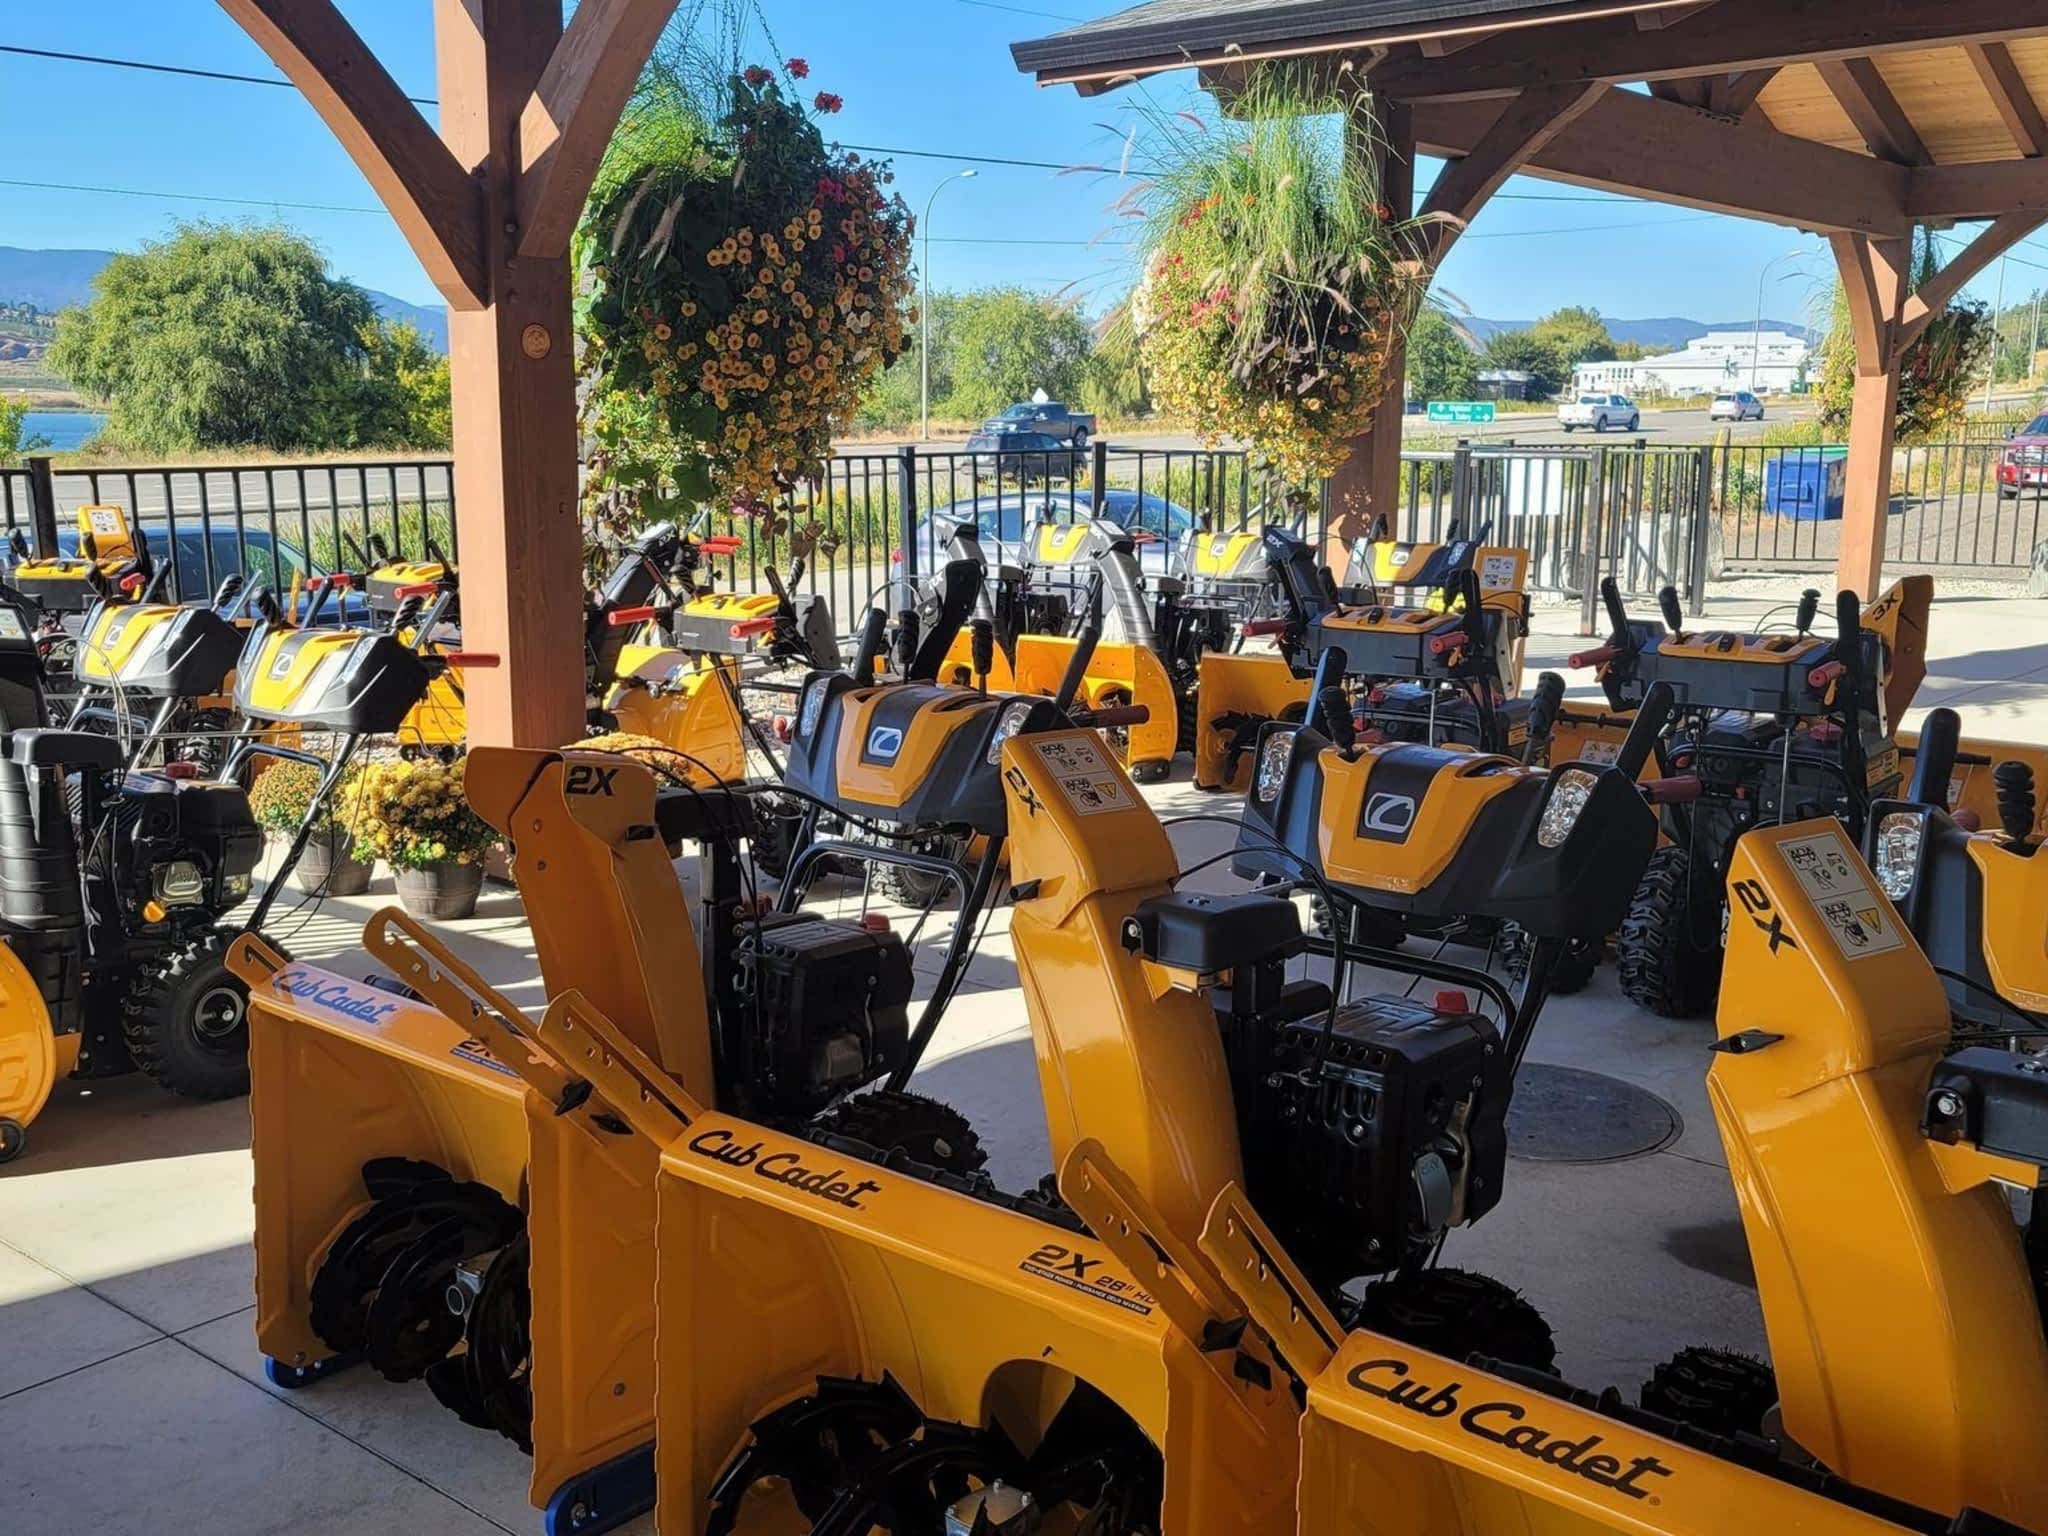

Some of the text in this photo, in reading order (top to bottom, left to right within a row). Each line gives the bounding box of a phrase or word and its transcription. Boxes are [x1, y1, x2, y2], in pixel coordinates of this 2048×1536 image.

[1872, 591, 1898, 621] 3X
[566, 766, 620, 796] 2X
[1004, 766, 1045, 817] 2X
[1731, 879, 1800, 958] 2X
[273, 971, 397, 1023] Cub Cadet
[688, 1130, 882, 1209] Cub Cadet
[1027, 1244, 1104, 1278] 2X
[1095, 1275, 1136, 1291] 28"
[1346, 1359, 1675, 1500] Cub Cadet
